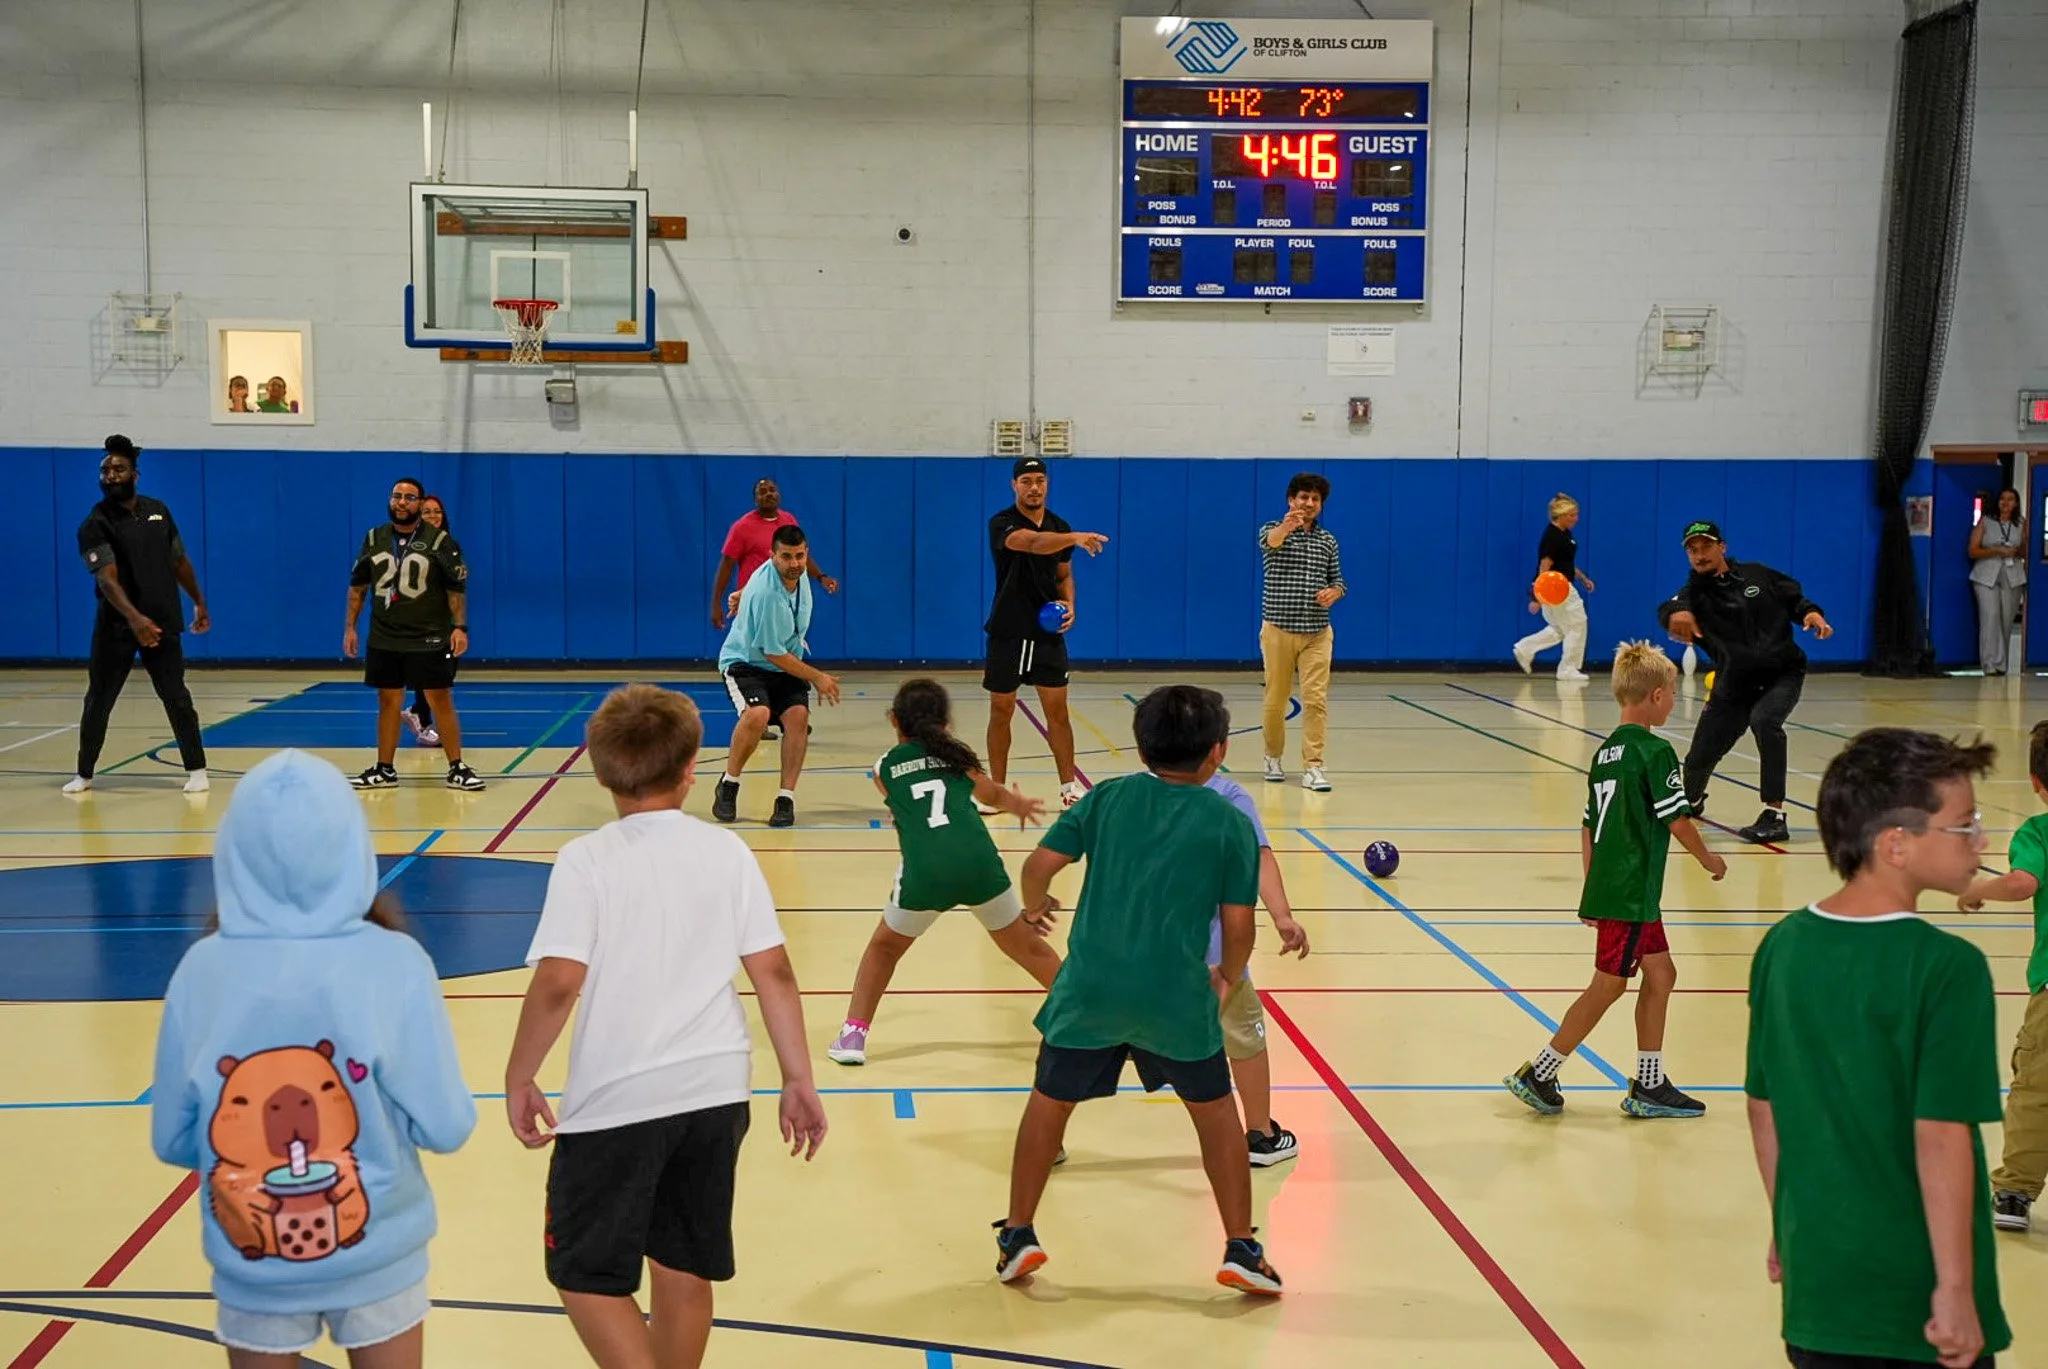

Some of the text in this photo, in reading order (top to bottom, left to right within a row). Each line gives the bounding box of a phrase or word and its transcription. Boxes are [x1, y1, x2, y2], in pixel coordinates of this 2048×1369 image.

[1253, 38, 1387, 49] BOYS & GIRLS CLUB
[1253, 49, 1307, 57] OF CLIFTON
[1208, 88, 1261, 116] 4:42
[1135, 134, 1198, 152] HOME
[1349, 136, 1418, 154] GUEST
[1243, 134, 1337, 180] 4:46
[1148, 201, 1176, 210] POSS
[1372, 203, 1399, 212] POSS
[1160, 215, 1196, 224] BONUS
[1257, 218, 1291, 228] PERIOD
[1351, 217, 1388, 226] BONUS
[1149, 238, 1182, 247] FOULS
[1235, 238, 1274, 248] PLAYER
[1288, 239, 1315, 248] FOUL
[1364, 239, 1397, 249] FOULS
[1148, 286, 1182, 295] SCORE
[1254, 286, 1291, 296] MATCH
[1363, 287, 1397, 297] SCORE
[371, 551, 430, 599] 20
[1598, 744, 1626, 765] WILSON
[910, 779, 950, 828] 7
